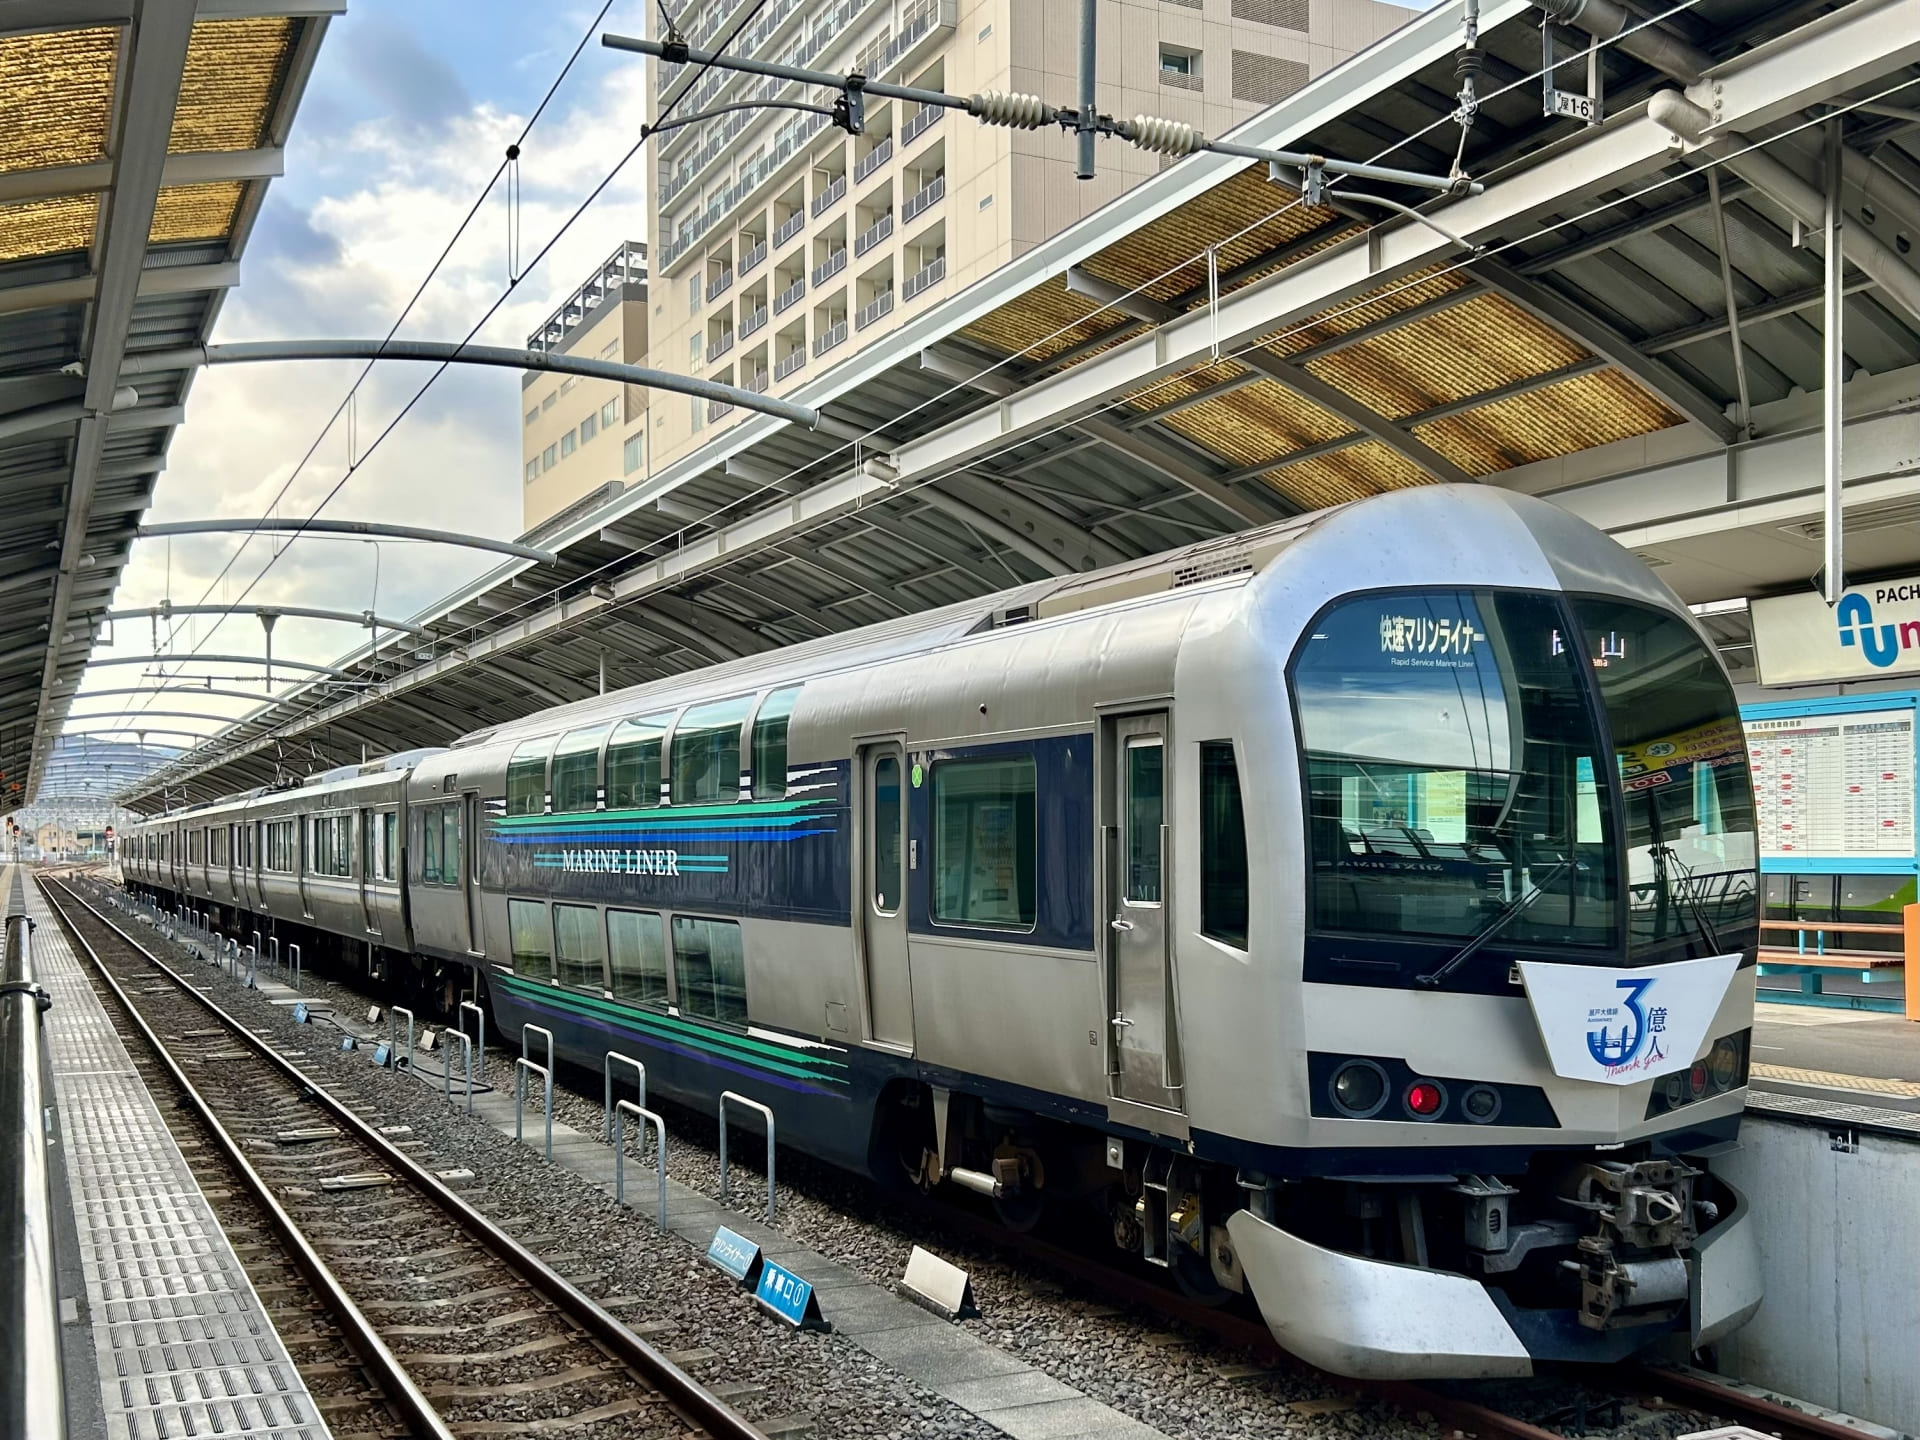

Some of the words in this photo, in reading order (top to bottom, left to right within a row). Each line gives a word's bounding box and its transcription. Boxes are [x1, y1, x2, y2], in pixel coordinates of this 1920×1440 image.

[1380, 614, 1485, 655] 快速マリンライナー
[1391, 657, 1410, 667] Rapid
[1411, 658, 1435, 667] Service
[1436, 659, 1457, 668] Marine
[1458, 660, 1475, 669] Liner
[562, 849, 621, 874] MARINE
[625, 849, 680, 877] LINER
[1605, 1056, 1641, 1079] Thank
